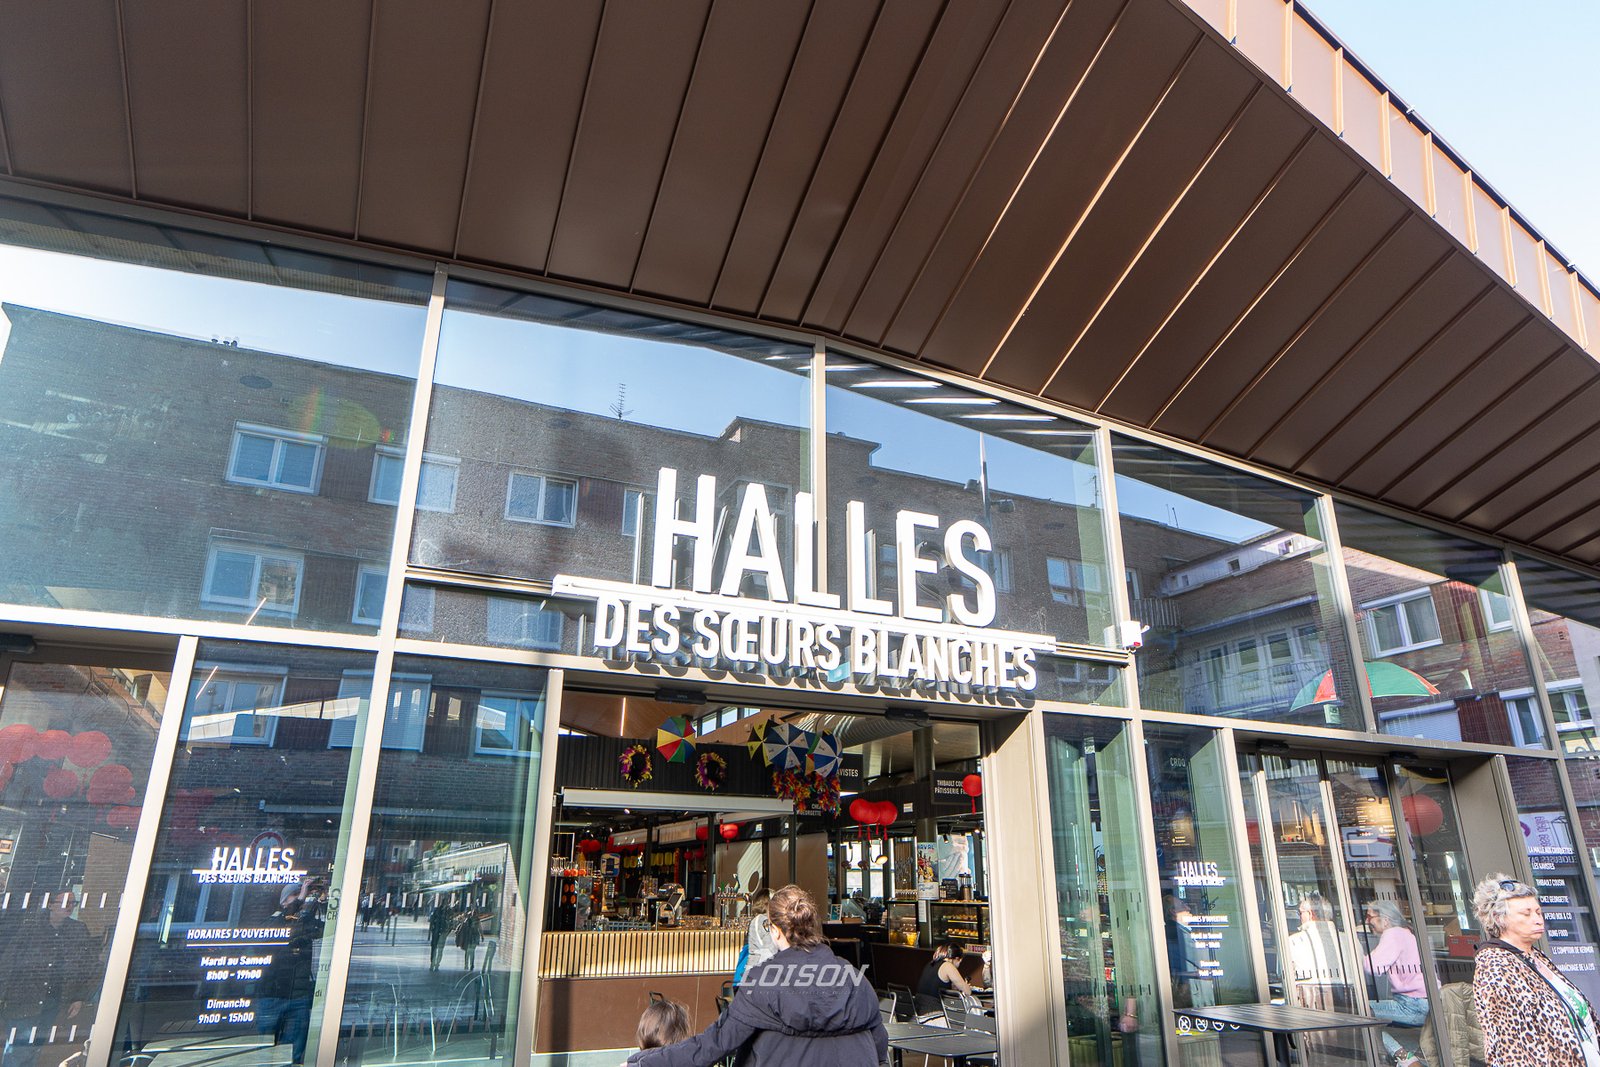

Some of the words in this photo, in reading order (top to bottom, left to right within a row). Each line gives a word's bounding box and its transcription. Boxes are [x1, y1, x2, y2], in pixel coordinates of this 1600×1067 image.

[651, 466, 997, 628] HALLES
[593, 594, 680, 655] DES
[694, 608, 842, 672] SŒURS
[853, 627, 1038, 691] BLANCHES
[836, 768, 858, 777] AVISTES
[211, 846, 296, 872] HALLES
[1180, 861, 1218, 877] HALLES
[198, 874, 218, 884] DES
[253, 874, 300, 884] BLANCHES
[187, 929, 232, 939] HORAIRES
[232, 928, 291, 939] D'OUVERTURE
[200, 956, 226, 967] Mardi
[228, 958, 238, 966] au
[239, 955, 272, 966] Samedi
[237, 970, 262, 980] 19h00
[206, 998, 251, 1009] Dimanche
[198, 1013, 220, 1024] 9h00
[228, 1012, 254, 1023] 15h00
